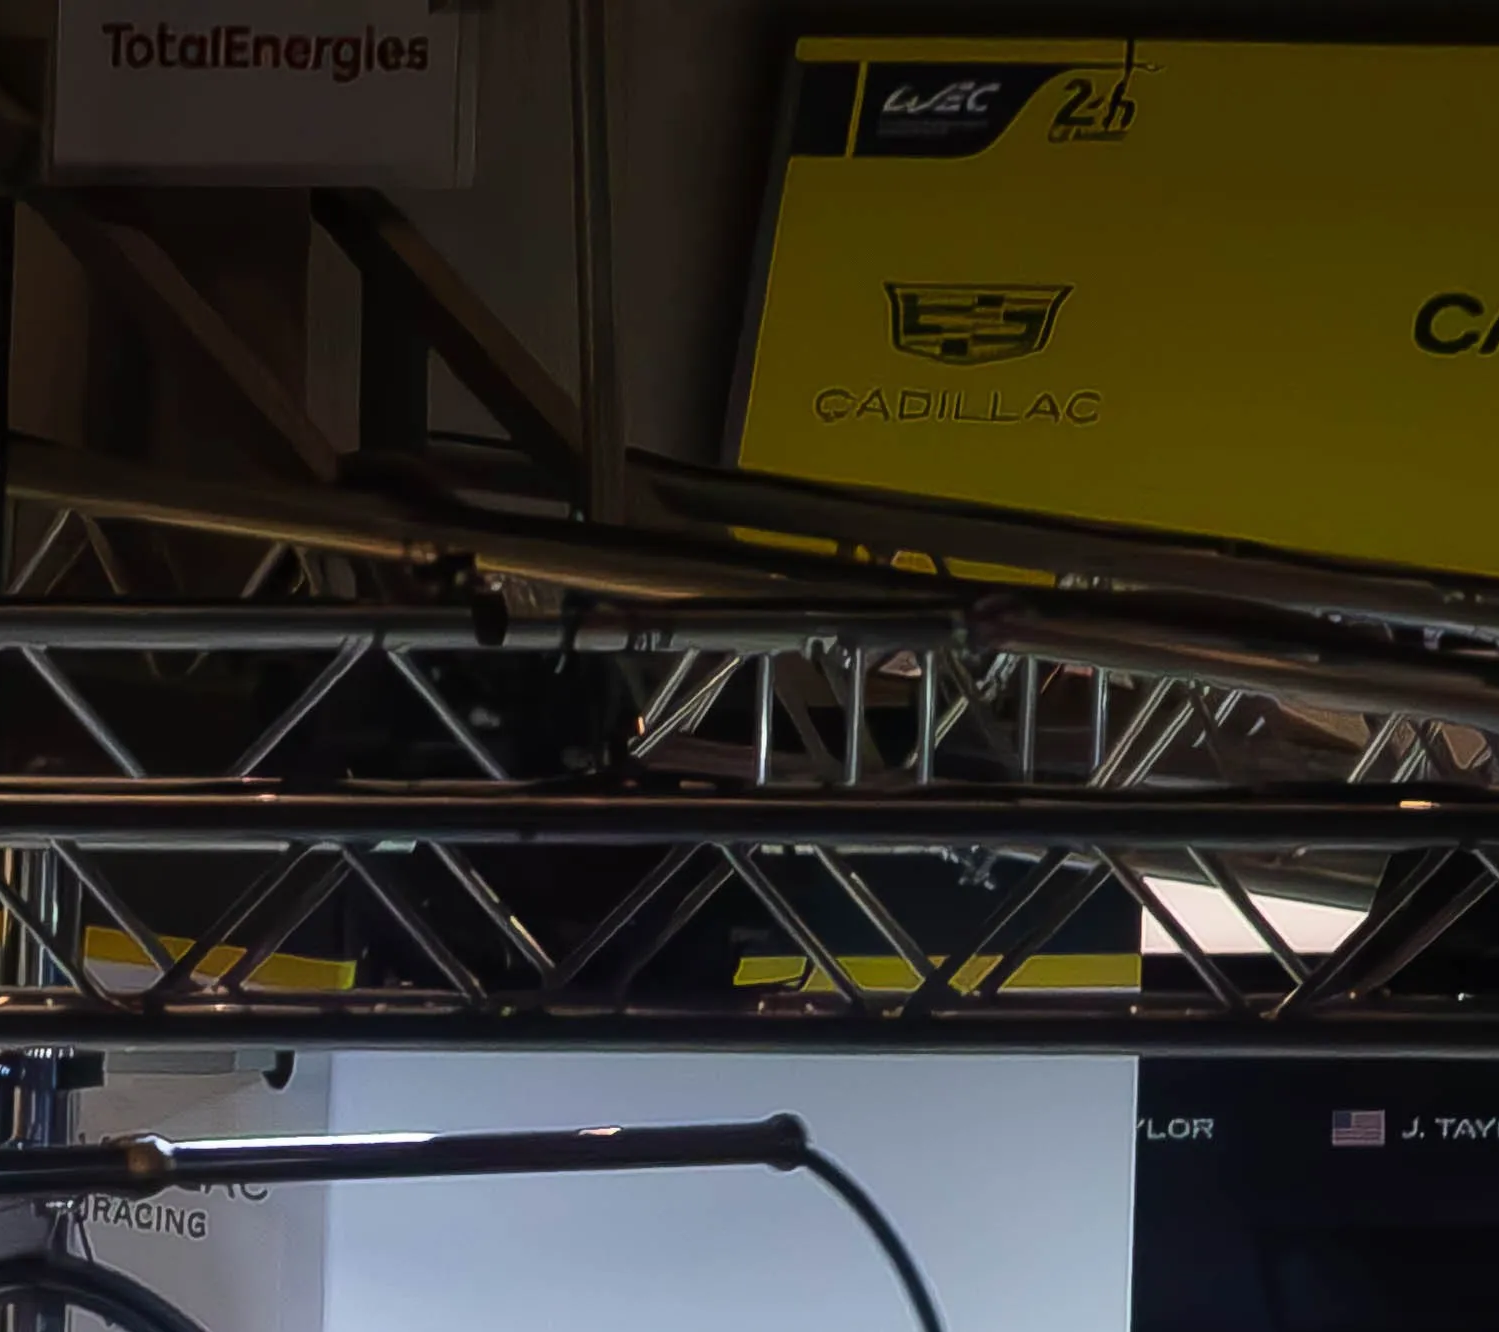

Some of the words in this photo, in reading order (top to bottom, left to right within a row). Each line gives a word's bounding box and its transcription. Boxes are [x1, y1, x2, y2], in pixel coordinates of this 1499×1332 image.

[101, 22, 430, 82] TotalEnergies
[881, 79, 1001, 114] WEC
[813, 385, 1105, 426] CADILLAC
[1136, 1117, 1215, 1142] LOR
[1401, 1116, 1428, 1142] J.
[92, 1196, 207, 1239] RACING
